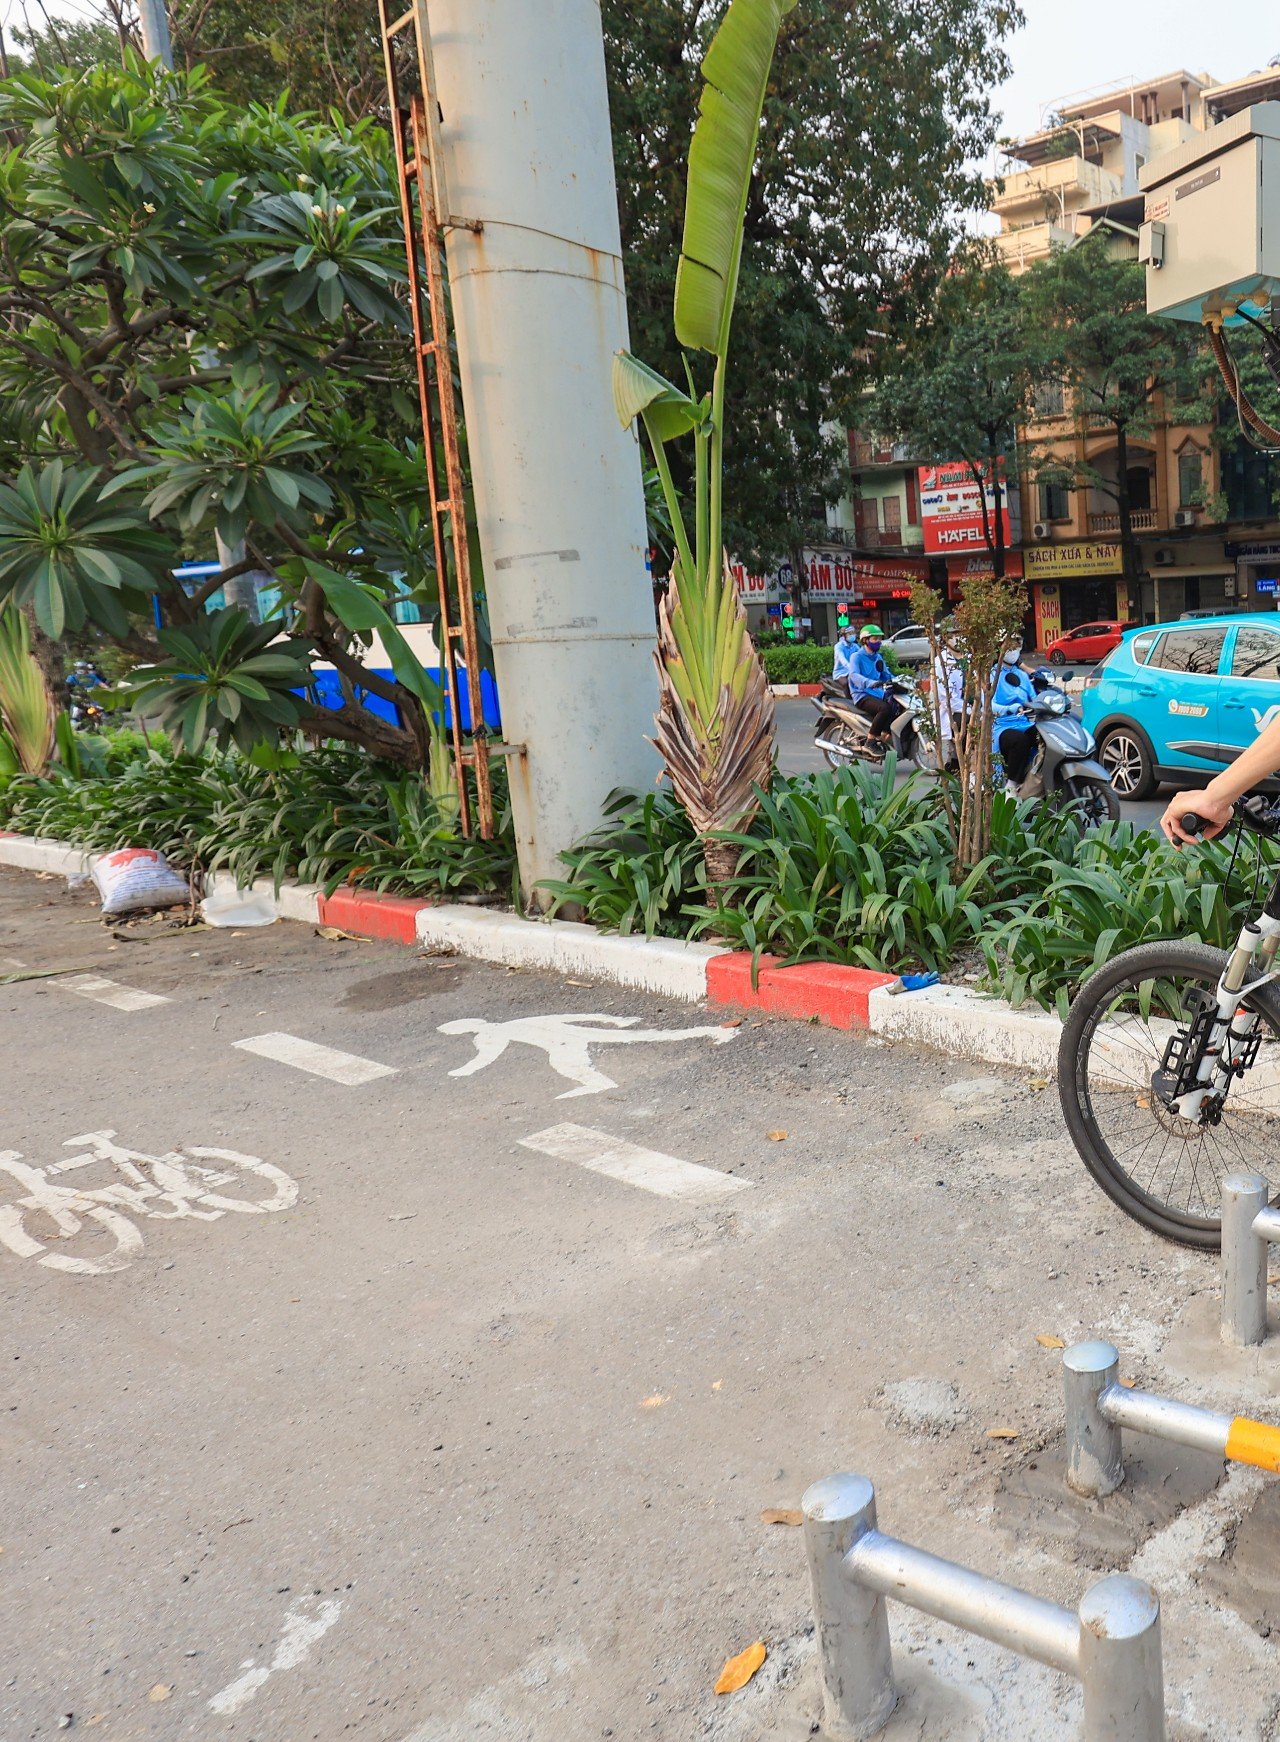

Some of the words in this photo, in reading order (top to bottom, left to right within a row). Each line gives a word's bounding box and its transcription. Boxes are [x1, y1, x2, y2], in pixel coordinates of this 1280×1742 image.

[1028, 549, 1056, 563] SÁCH
[1060, 546, 1081, 560] XƯA
[1085, 546, 1092, 559] &
[1096, 545, 1118, 558] NAY
